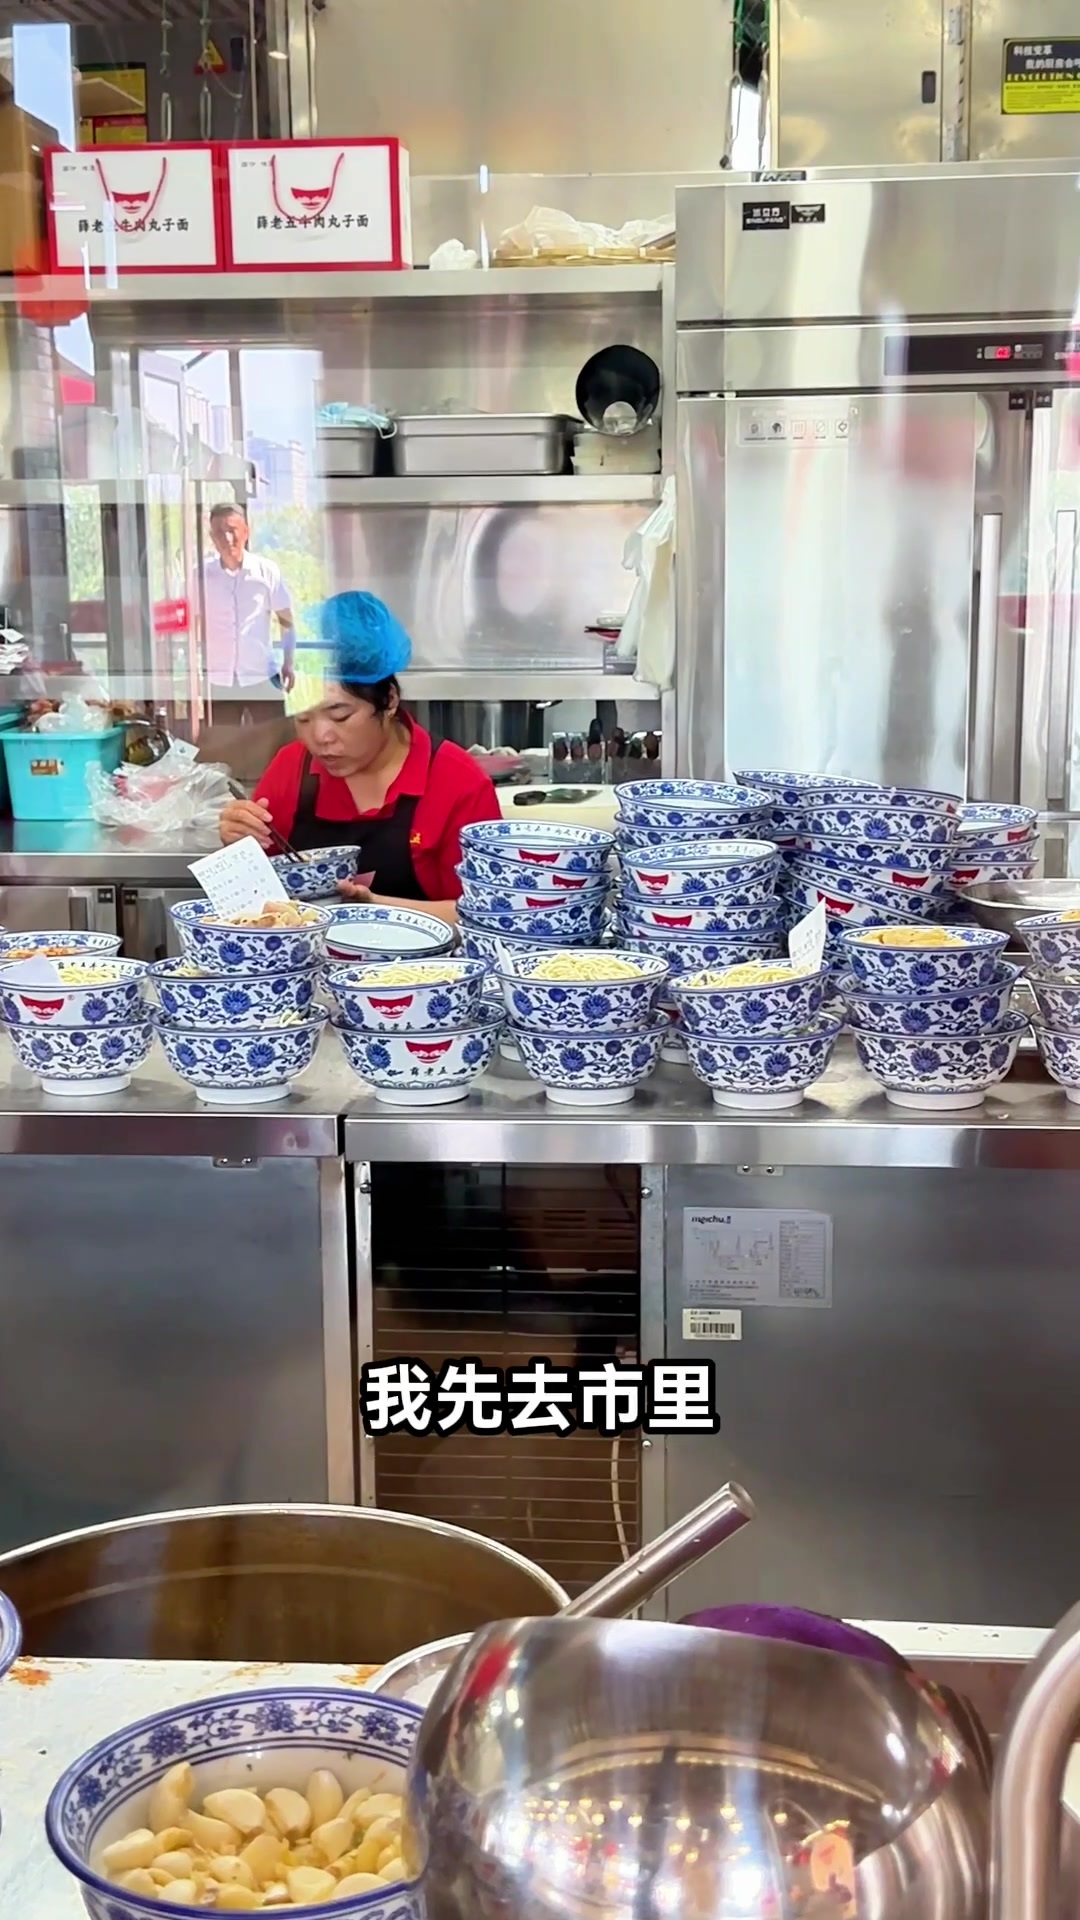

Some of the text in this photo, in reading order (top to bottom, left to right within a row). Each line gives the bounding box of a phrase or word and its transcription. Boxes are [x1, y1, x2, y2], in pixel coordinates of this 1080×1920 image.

[78, 218, 189, 233] 薛老牛肉丸子面
[256, 214, 369, 230] 薛老五牛肉丸子面
